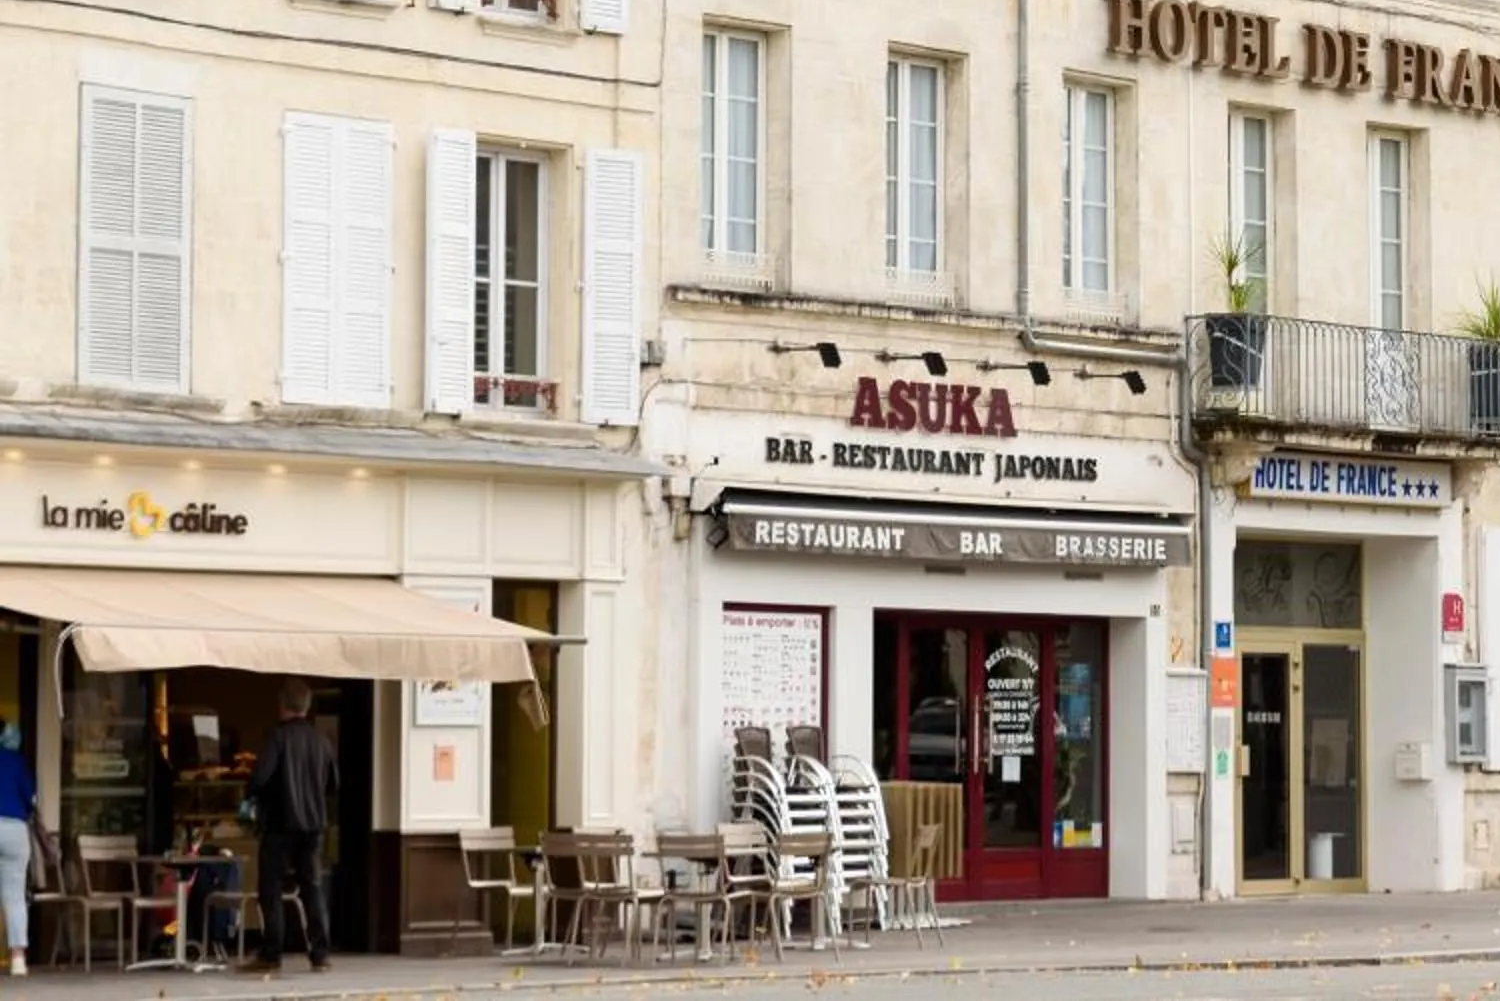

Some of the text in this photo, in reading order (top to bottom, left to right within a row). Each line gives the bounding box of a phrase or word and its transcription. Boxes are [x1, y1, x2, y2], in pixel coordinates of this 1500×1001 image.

[1302, 23, 1372, 90] DE
[850, 375, 1018, 437] ASUKA
[765, 437, 814, 465] BAR
[833, 442, 985, 477] RESTAURANT
[993, 452, 1098, 482] JAPONAIS
[1255, 456, 1398, 498] HOTEL DE FRANCE
[41, 494, 249, 535] la mie câline
[755, 520, 1167, 561] RESTAURANT BAR BRASSERIE
[987, 678, 1020, 690] OUVERT
